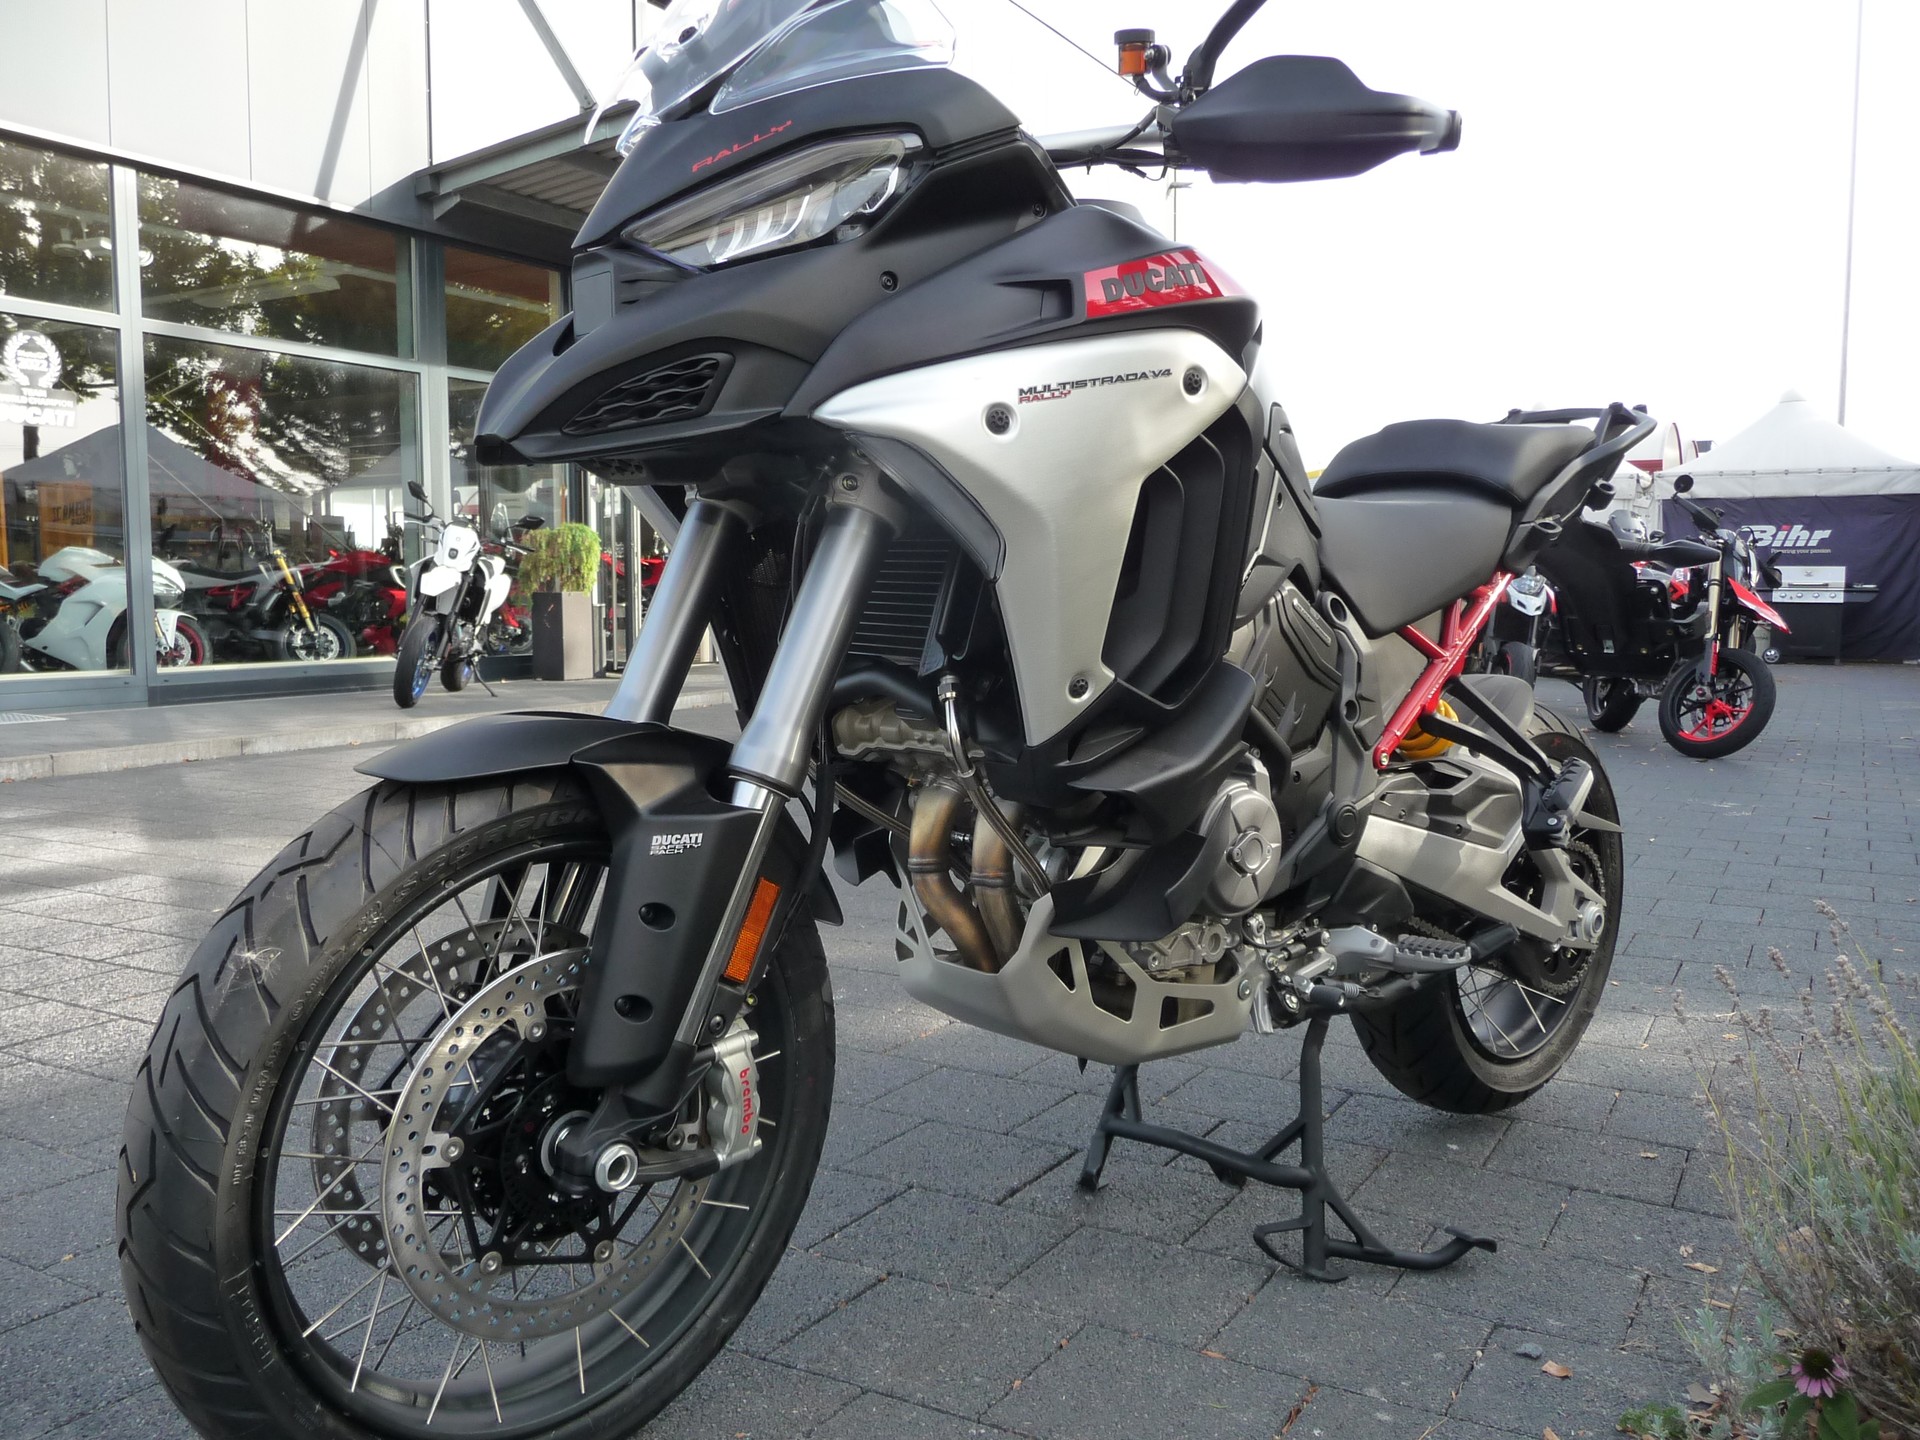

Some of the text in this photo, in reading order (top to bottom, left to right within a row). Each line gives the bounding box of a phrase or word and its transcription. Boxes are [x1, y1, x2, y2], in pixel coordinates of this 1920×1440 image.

[692, 120, 792, 172] RALLY
[1101, 262, 1208, 302] DUCATI
[1019, 368, 1173, 396] MULTISTRADA V4
[1018, 390, 1072, 404] RALLY
[1741, 524, 1832, 547] Bihr
[651, 833, 703, 846] DUCATI
[740, 1067, 754, 1134] brembo
